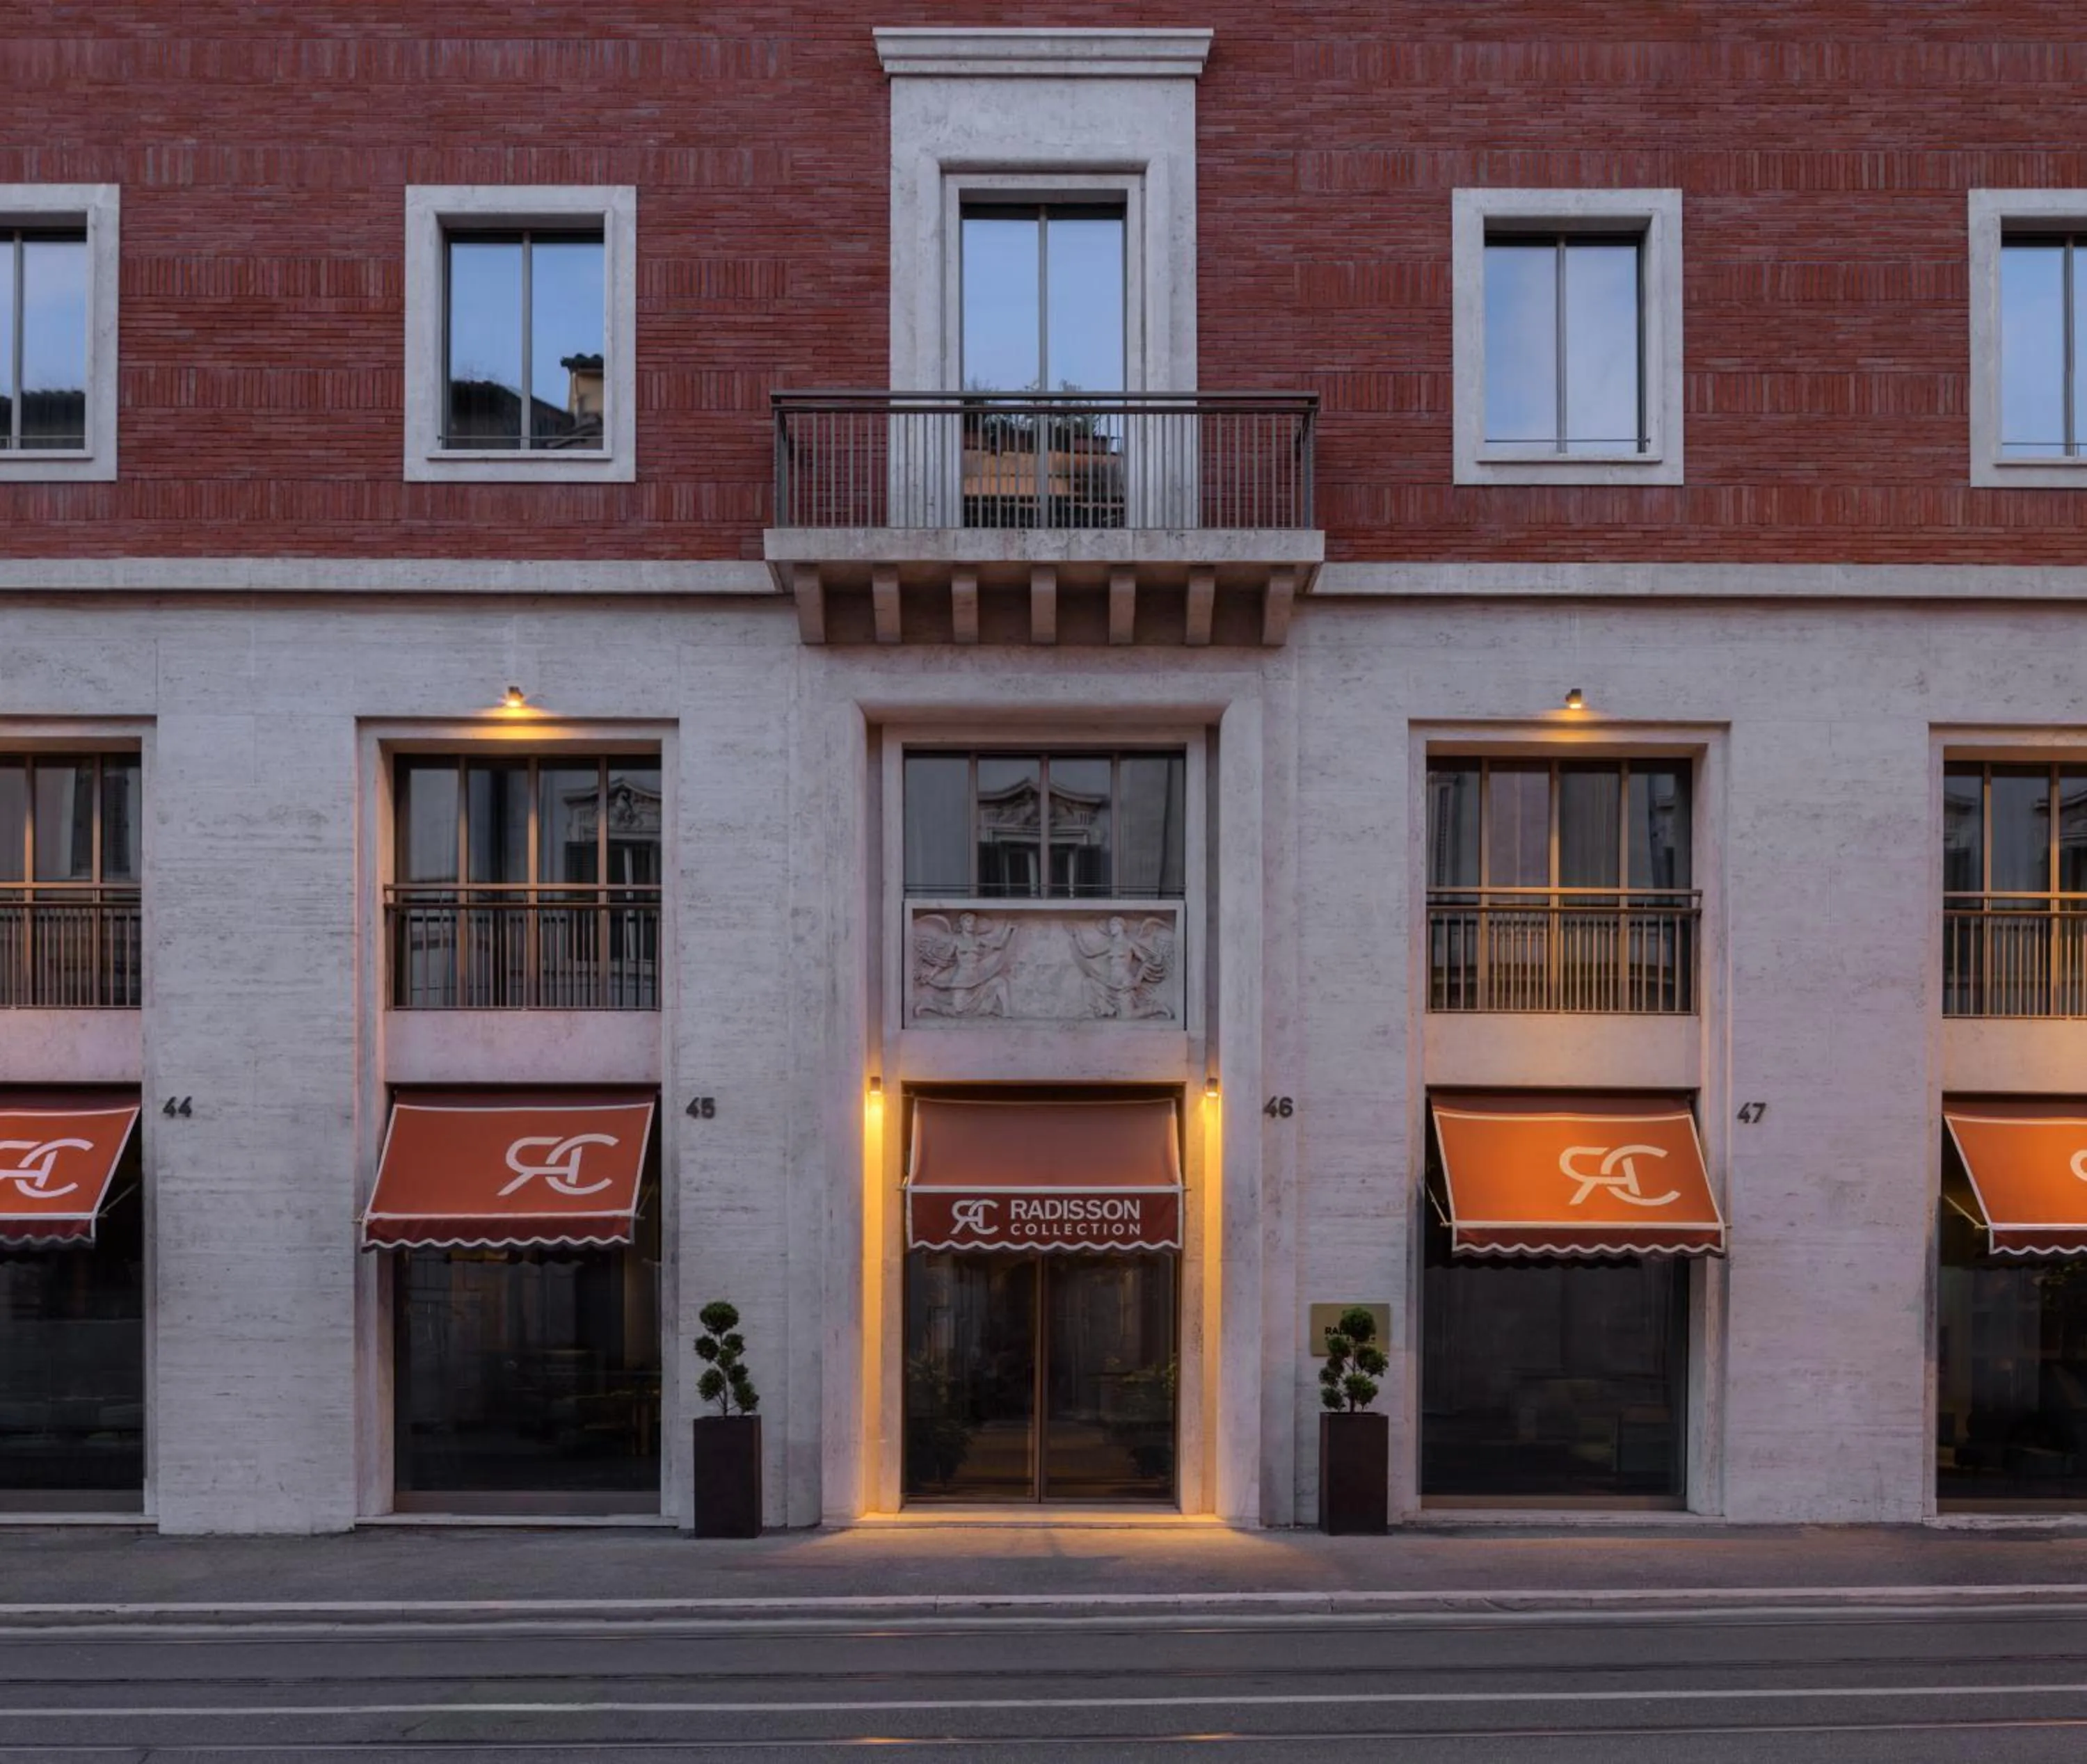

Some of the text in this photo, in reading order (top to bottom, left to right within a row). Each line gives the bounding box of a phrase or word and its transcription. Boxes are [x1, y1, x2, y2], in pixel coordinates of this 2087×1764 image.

[163, 1096, 193, 1118] 44
[686, 1097, 715, 1119] 45
[1263, 1096, 1294, 1118] 46
[1736, 1102, 1767, 1124] 47
[1010, 1199, 1141, 1220] RADISSON
[1010, 1223, 1141, 1236] COLLECTION
